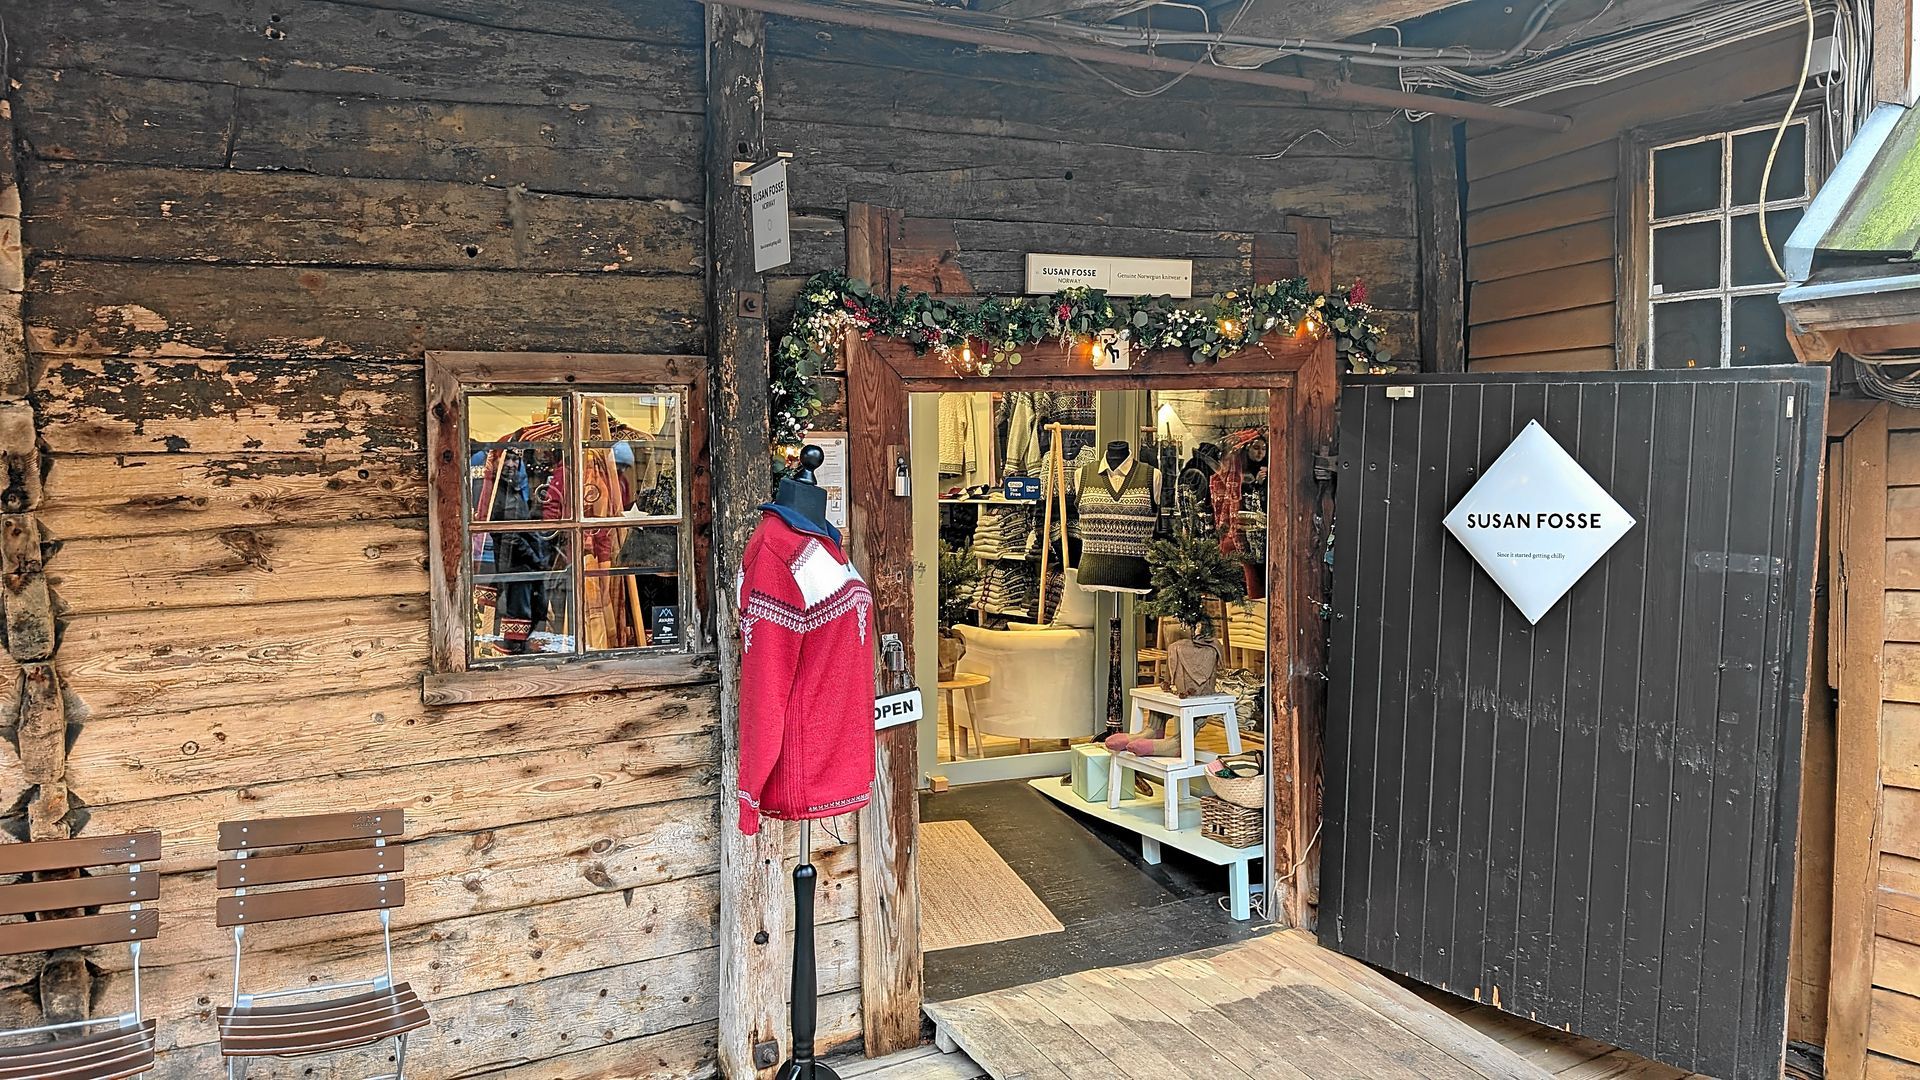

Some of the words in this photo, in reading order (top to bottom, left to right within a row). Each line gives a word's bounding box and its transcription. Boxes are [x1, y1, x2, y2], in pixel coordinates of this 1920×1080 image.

[752, 186, 768, 204] SUSAN
[769, 180, 784, 197] FOSSE
[1042, 267, 1070, 276] SUSAN
[1072, 268, 1097, 277] FOSSE
[1467, 513, 1530, 529] SUSAN
[1536, 513, 1602, 529] FOSSE
[875, 700, 914, 720] OPEN
